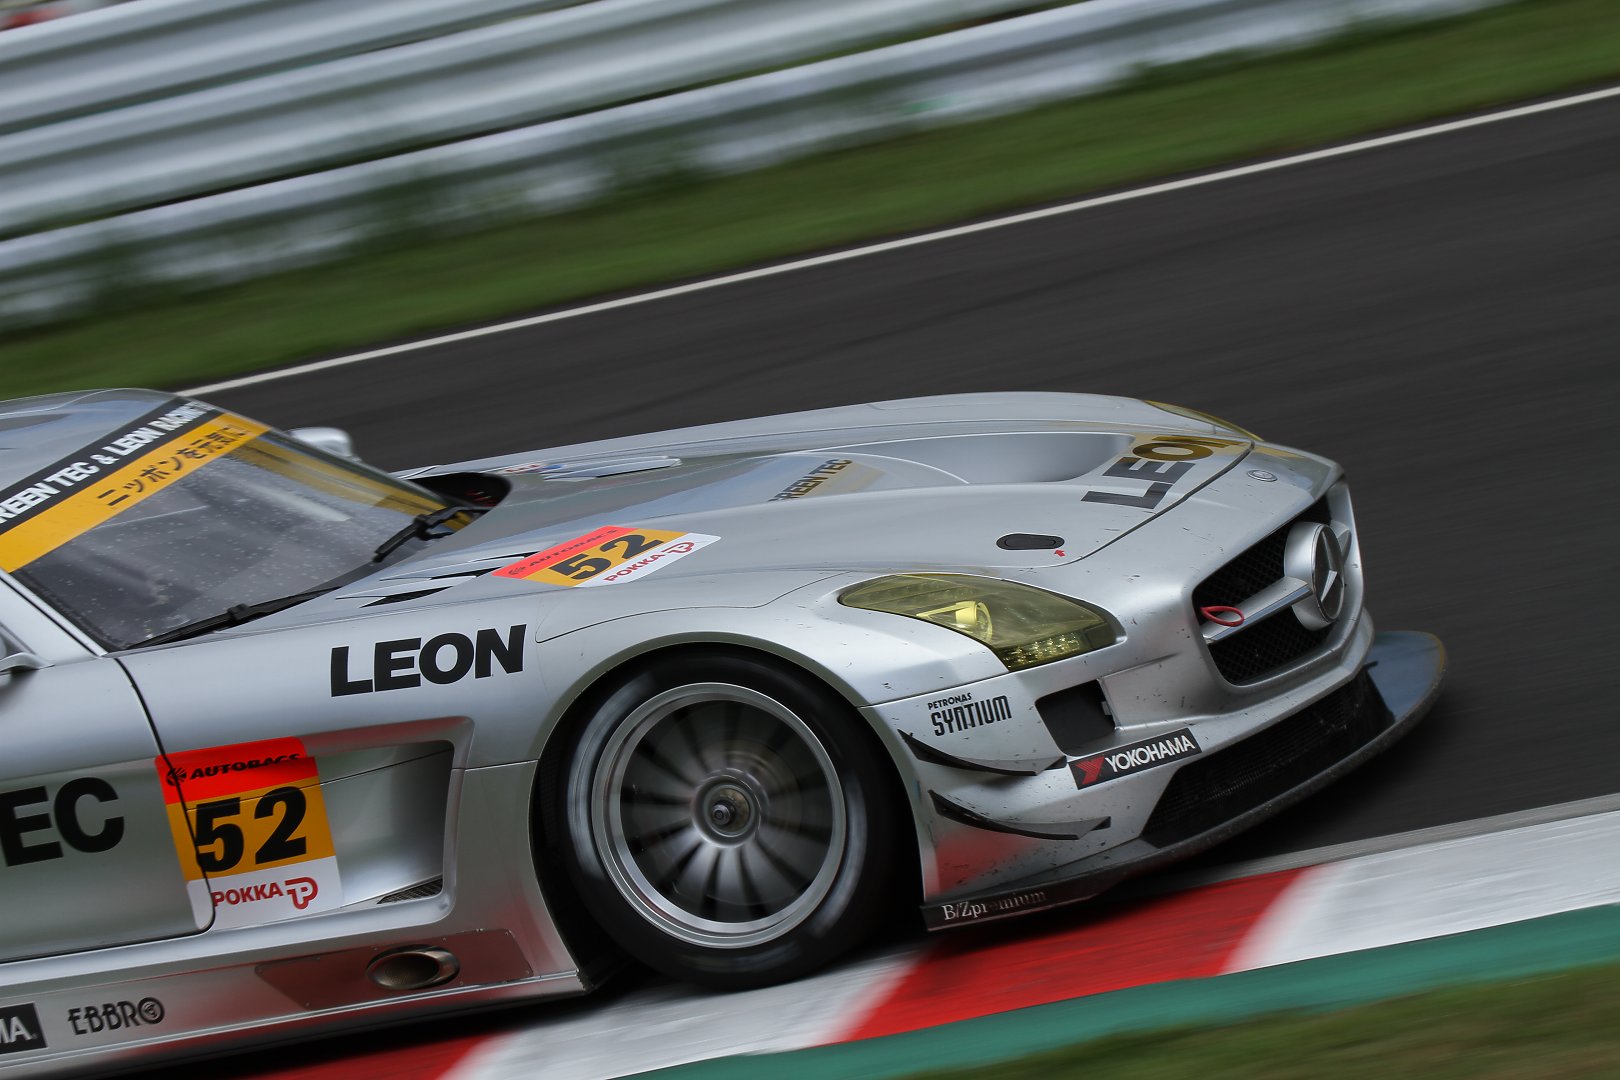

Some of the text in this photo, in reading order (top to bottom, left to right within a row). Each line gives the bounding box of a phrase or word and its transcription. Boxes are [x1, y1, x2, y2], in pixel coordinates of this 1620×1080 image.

[102, 427, 167, 455] LEON
[43, 462, 100, 487] TEC
[90, 455, 119, 465] &
[808, 459, 853, 474] TEC
[1081, 435, 1246, 509] LEON
[548, 535, 664, 580] 52
[603, 553, 665, 582] POKKA
[331, 624, 527, 697] LEON
[928, 692, 972, 710] PETRONAS
[931, 695, 1012, 736] SYNTIUM
[1105, 735, 1195, 773] YOKOHAMA
[195, 786, 307, 872] 52
[211, 882, 284, 907] POKKA
[67, 997, 165, 1035] EBBRO
